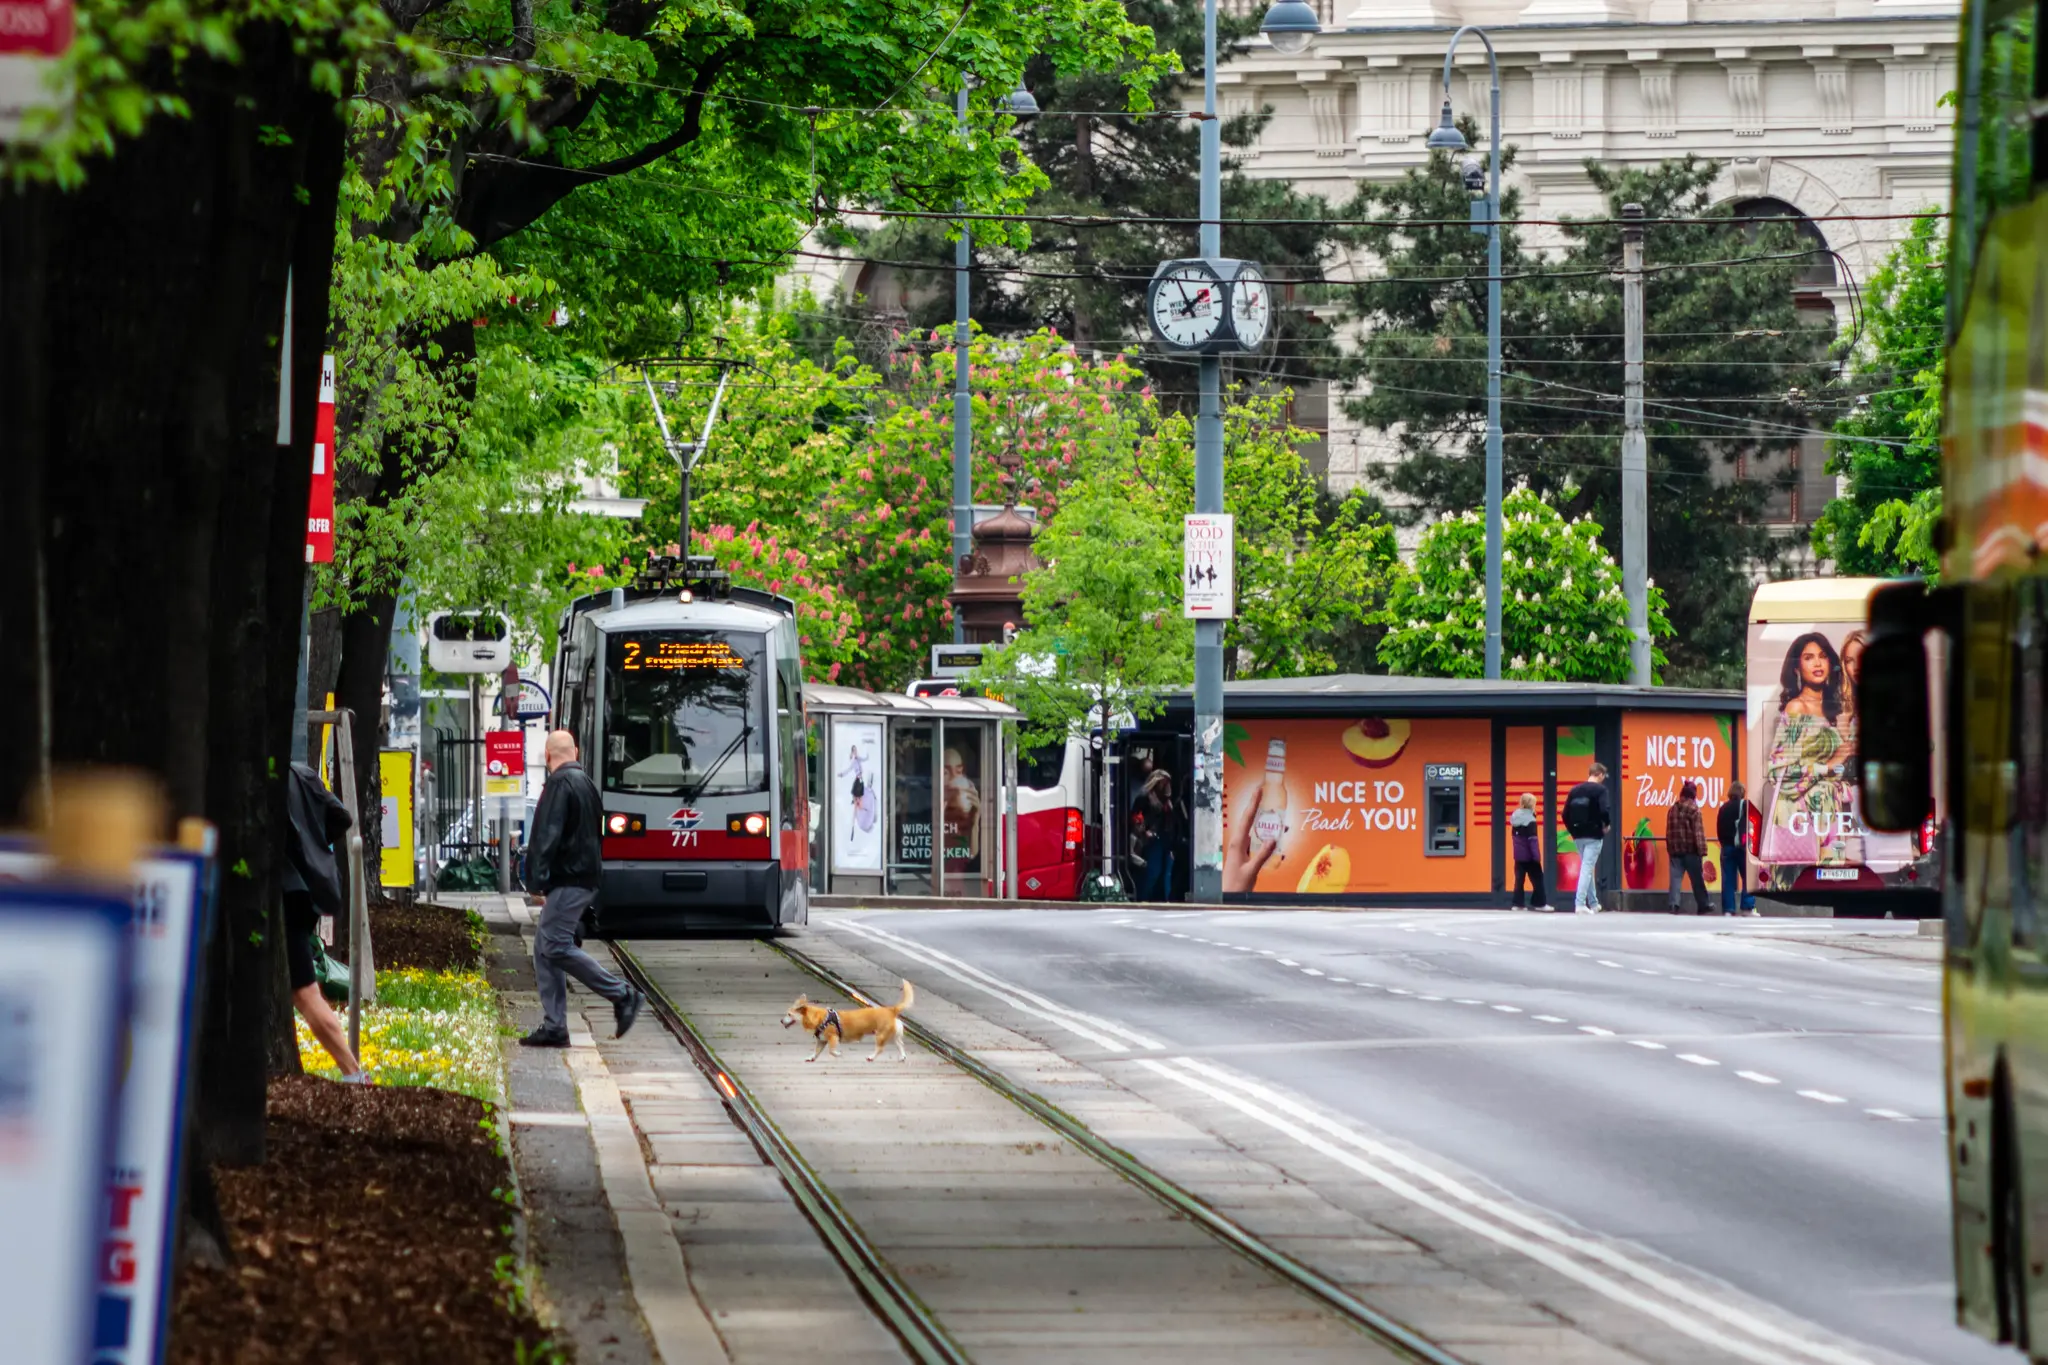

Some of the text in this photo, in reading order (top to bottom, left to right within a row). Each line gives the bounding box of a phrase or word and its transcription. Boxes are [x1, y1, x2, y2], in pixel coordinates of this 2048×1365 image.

[1189, 526, 1223, 540] OOD
[1187, 550, 1222, 563] ITY!
[624, 642, 730, 670] 2 Friedrich
[1646, 735, 1715, 769] NICE TO
[1439, 767, 1463, 776] CASH
[1314, 781, 1405, 803] NICE TO
[1636, 773, 1677, 807] Peach
[902, 823, 958, 834] WIRKCH
[1300, 807, 1417, 831] Peach YOU!
[671, 831, 698, 847] 771
